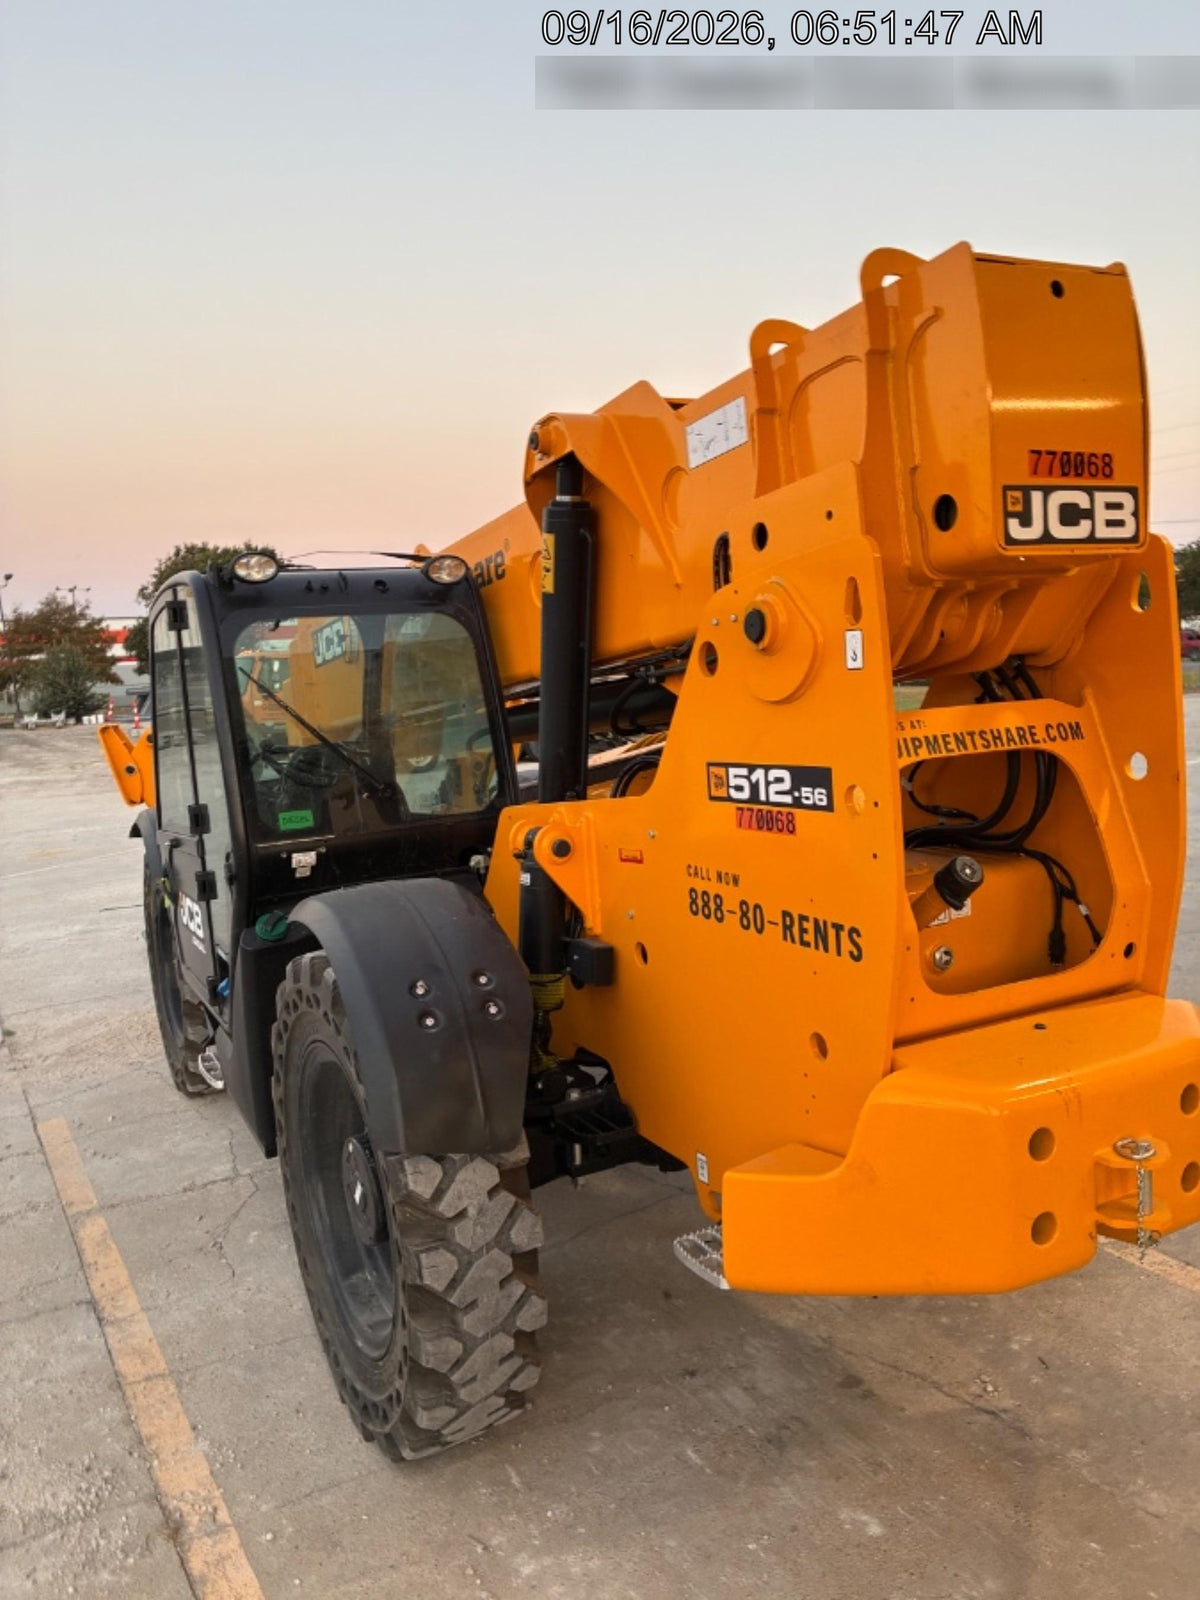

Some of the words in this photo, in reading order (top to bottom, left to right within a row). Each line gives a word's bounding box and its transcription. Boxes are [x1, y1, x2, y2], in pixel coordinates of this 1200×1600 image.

[1029, 449, 1114, 478] 770068
[1007, 490, 1137, 540] JCB
[736, 807, 796, 834] 770068
[686, 863, 712, 882] CALL
[716, 870, 741, 888] NOW
[180, 896, 204, 939] JCB
[688, 886, 864, 963] 888-80-RENTS
